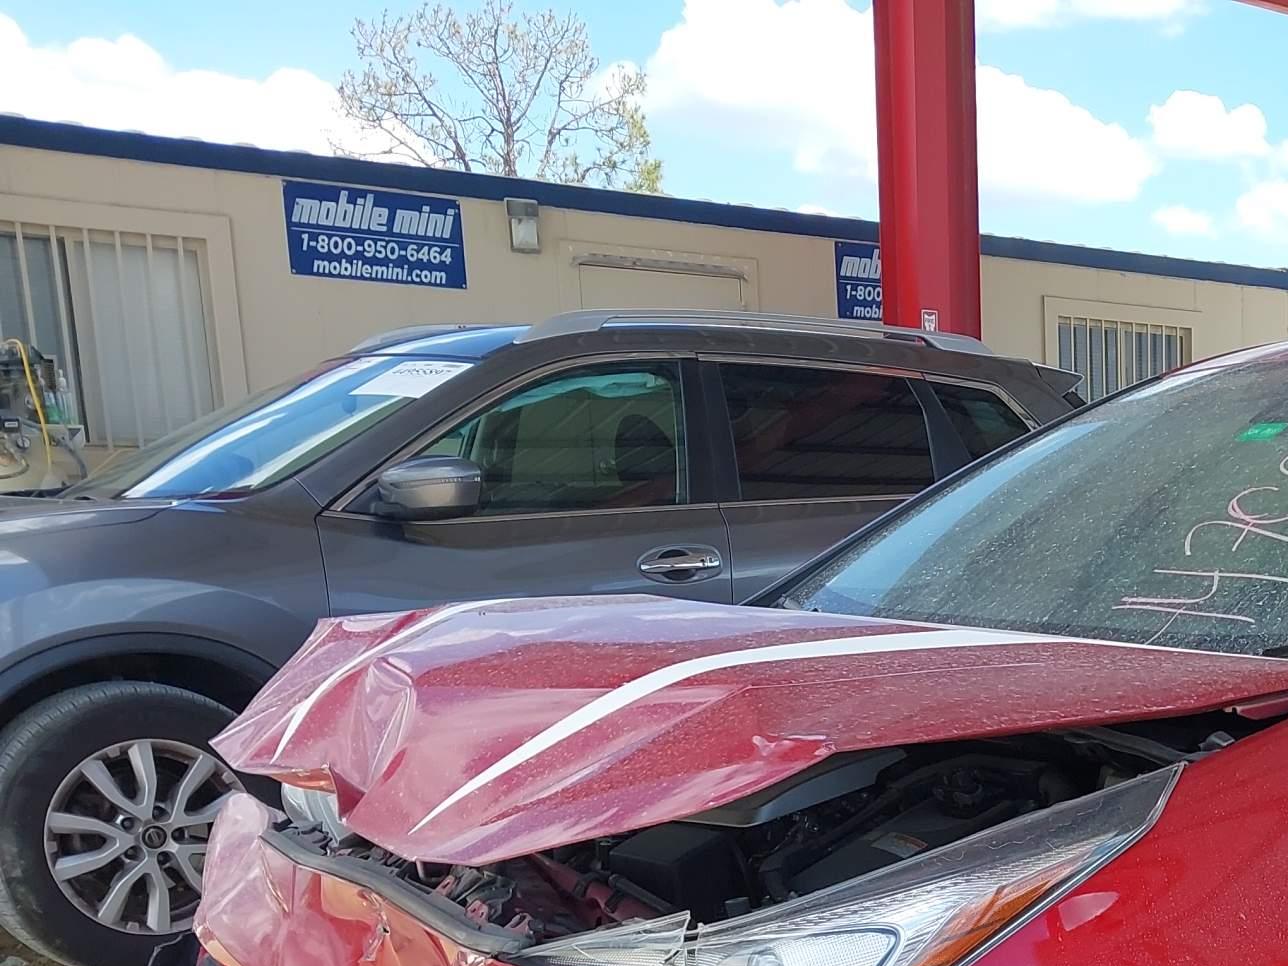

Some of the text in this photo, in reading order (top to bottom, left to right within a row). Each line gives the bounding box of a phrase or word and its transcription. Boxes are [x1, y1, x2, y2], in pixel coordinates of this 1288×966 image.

[292, 190, 455, 239] mobile mini
[301, 234, 452, 265] 1-800-950-6464
[313, 259, 447, 285] mobilemini.com
